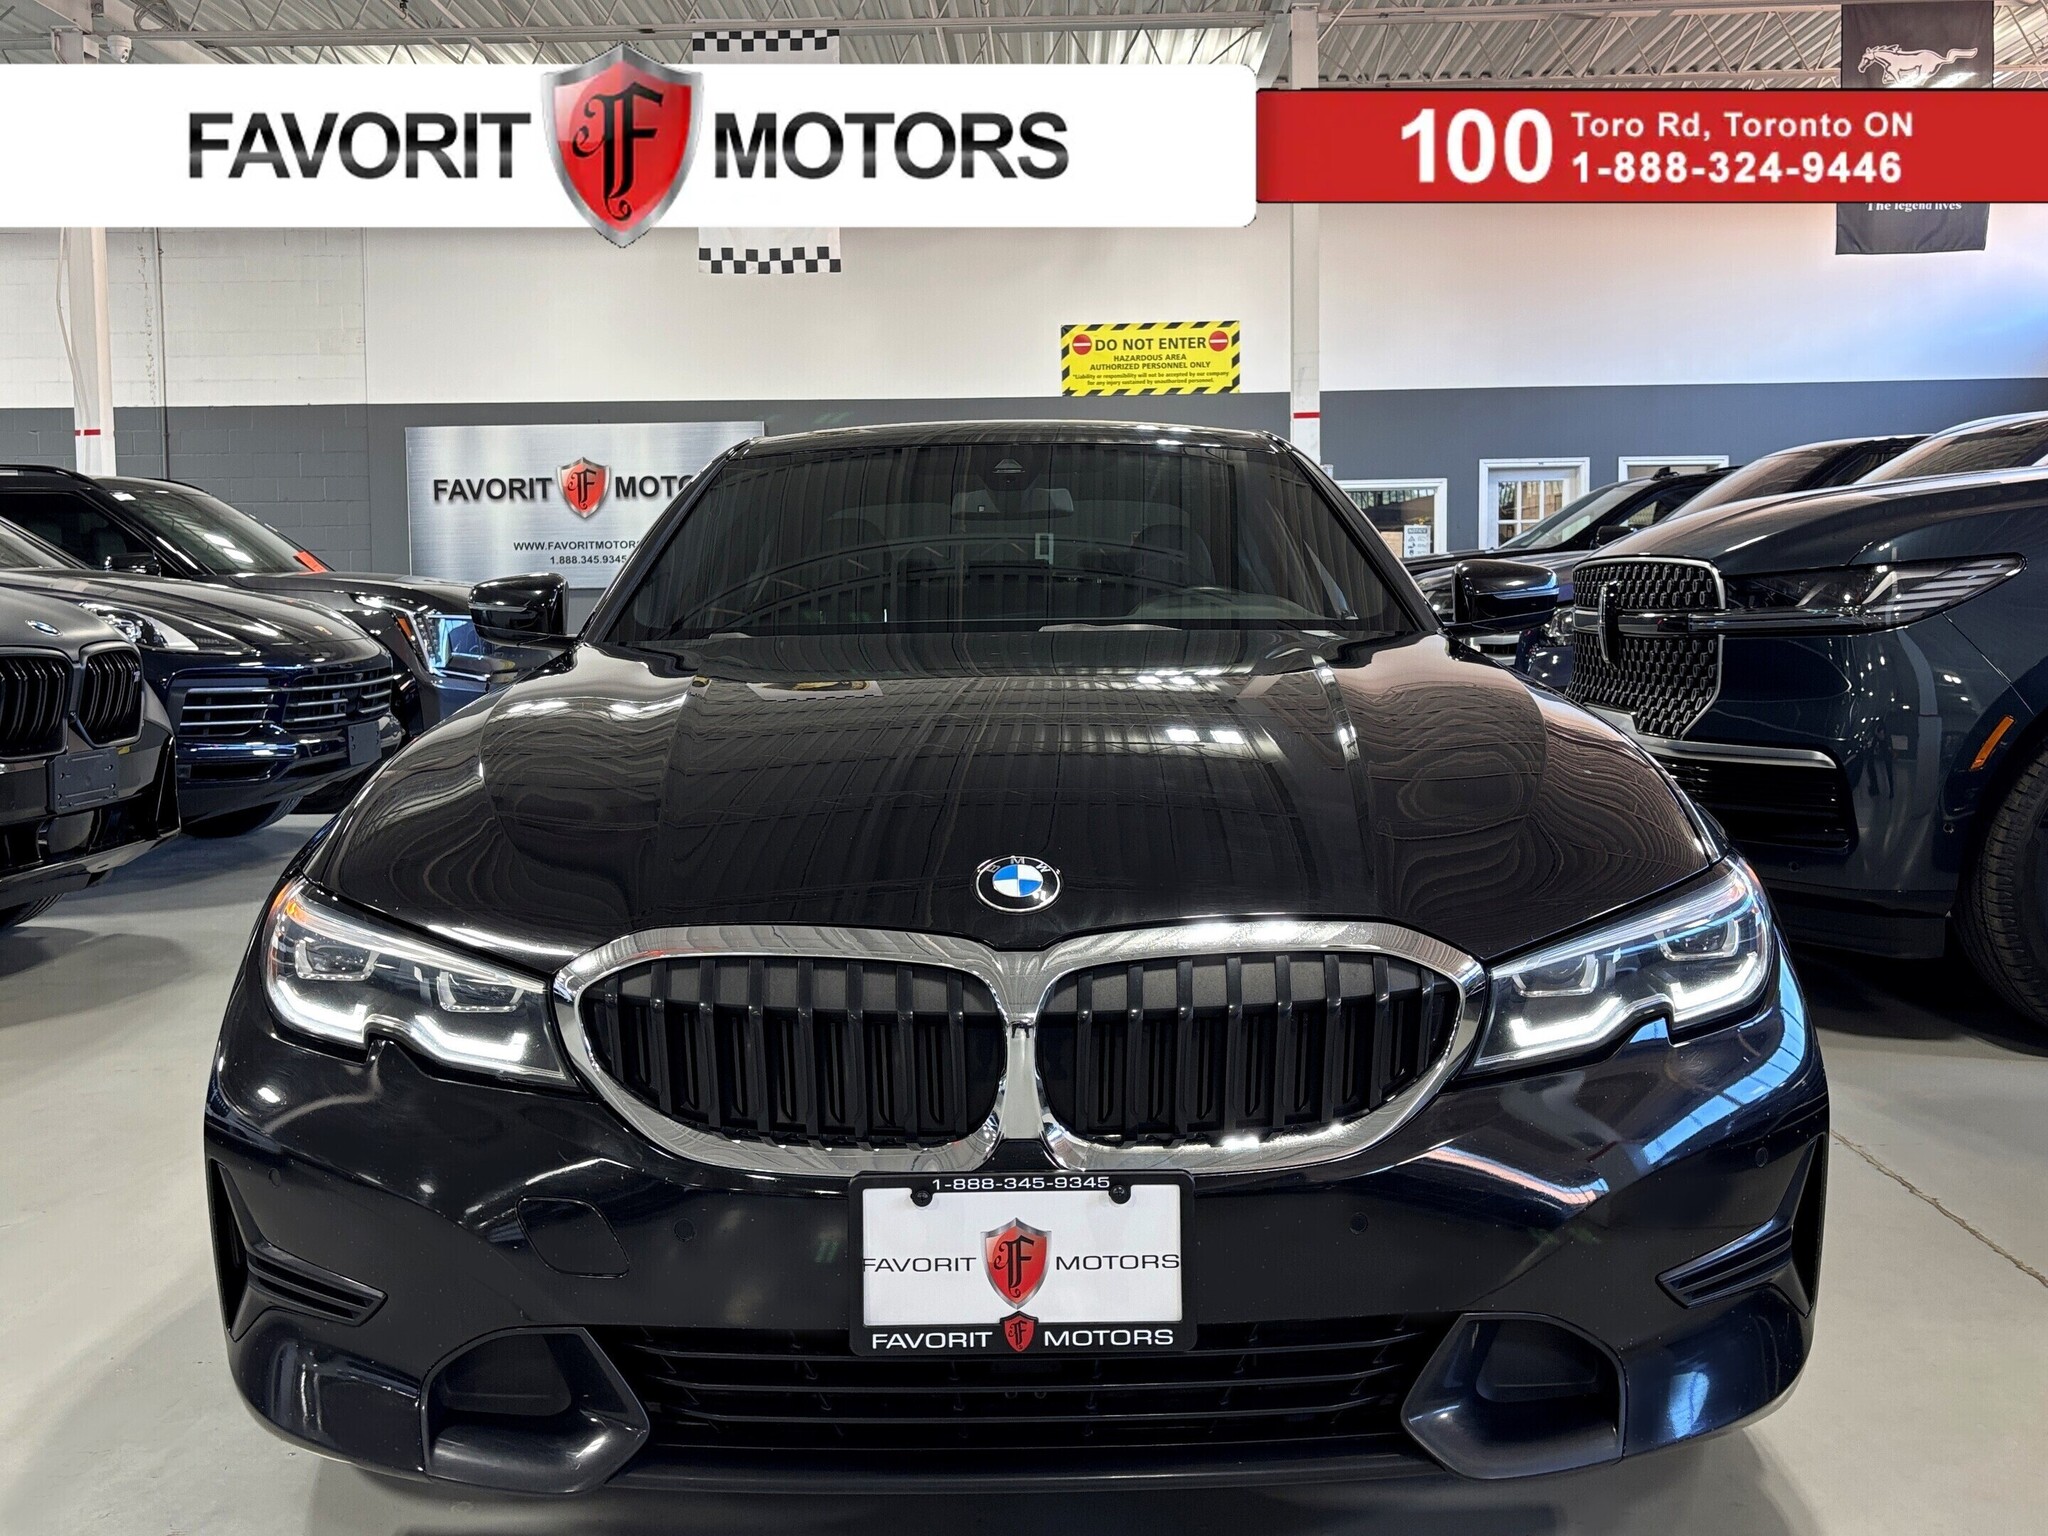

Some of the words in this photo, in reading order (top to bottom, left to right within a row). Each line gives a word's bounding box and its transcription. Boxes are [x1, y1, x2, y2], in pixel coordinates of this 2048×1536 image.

[1095, 339, 1117, 351] DO
[1123, 338, 1154, 351] NOT
[1159, 337, 1207, 349] ENTER
[1113, 354, 1163, 362] HAZARDOUS
[1165, 353, 1187, 361] AREA
[1090, 363, 1140, 371] AUTHORIZED
[1142, 362, 1188, 370] PERSONNEL
[433, 477, 553, 501] FAVORIT
[513, 540, 640, 551] WWW.FAVORITMOTOR
[985, 857, 1052, 874] BMW
[932, 1177, 1111, 1191] 1-888-345-9345
[863, 1257, 977, 1273] FAVORIT
[1056, 1254, 1180, 1271] MOTORS
[872, 1332, 993, 1350] FAVORIT
[1044, 1329, 1175, 1347] MOTORS
